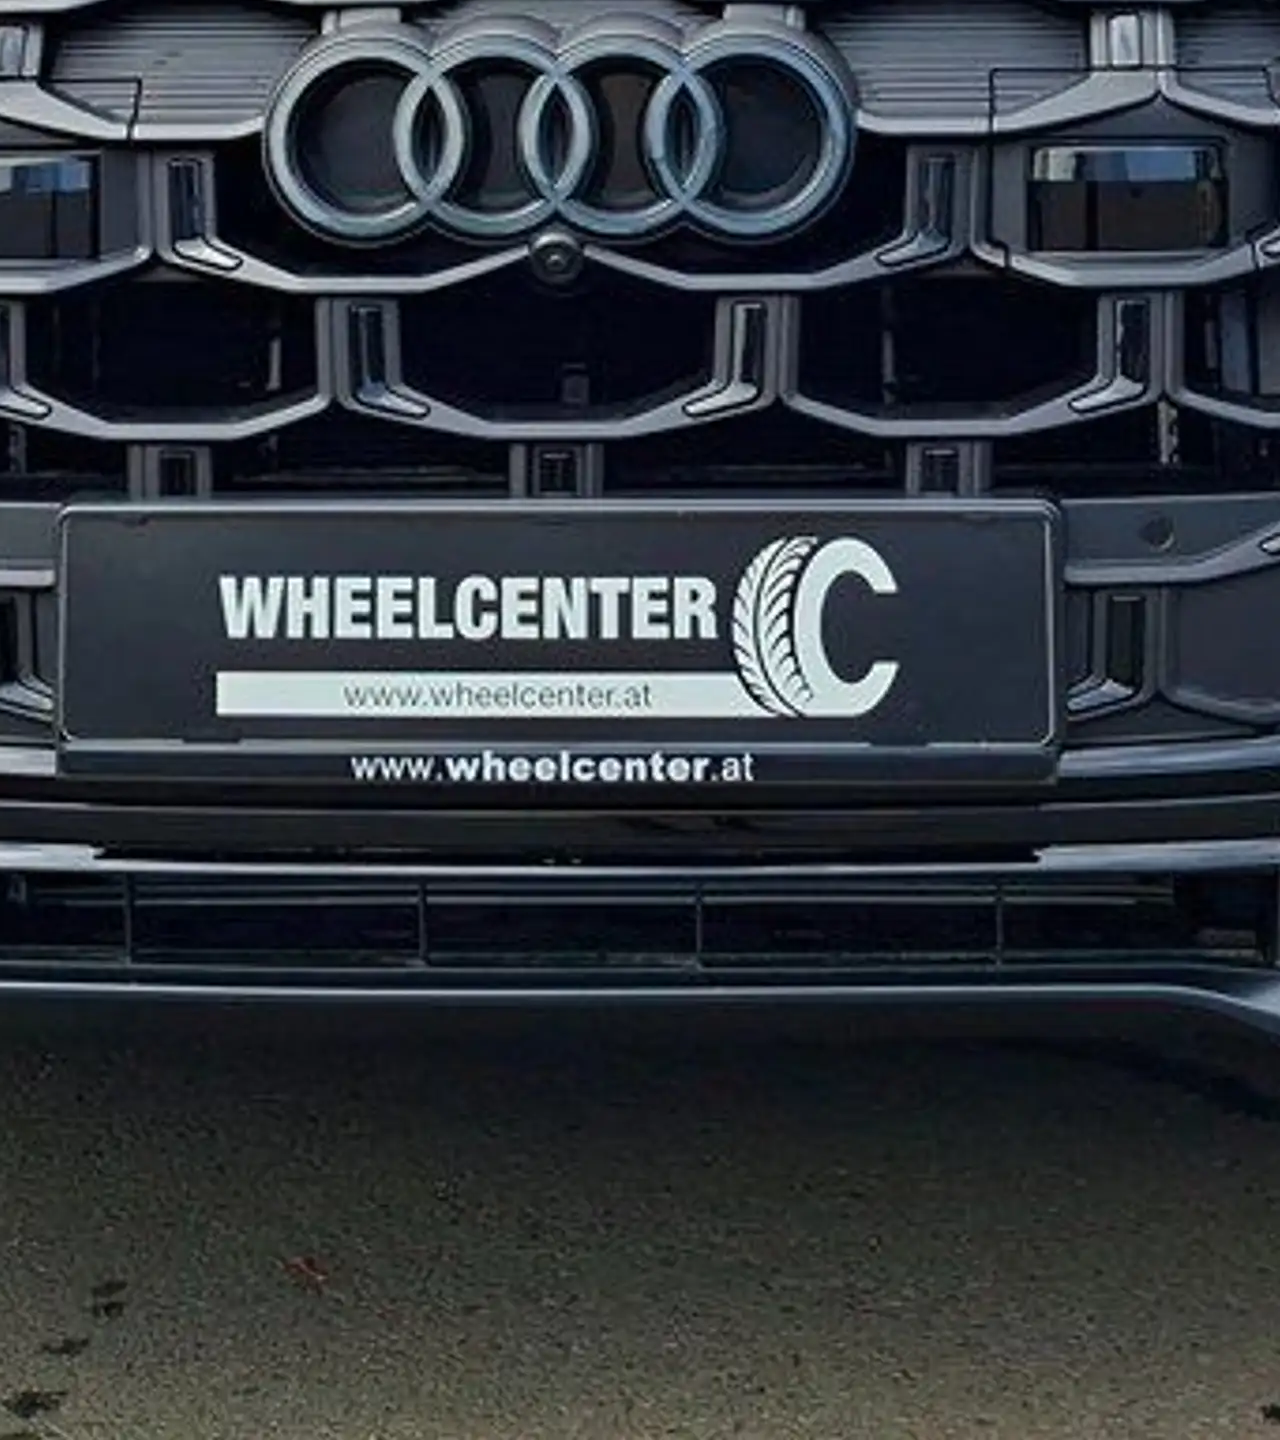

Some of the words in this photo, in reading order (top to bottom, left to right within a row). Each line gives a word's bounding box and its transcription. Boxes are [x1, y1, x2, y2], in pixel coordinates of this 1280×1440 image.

[219, 575, 718, 641] WHEELCENTER
[343, 680, 653, 708] www.wheelcenter.at
[351, 749, 756, 783] www.wheelcenter.at
